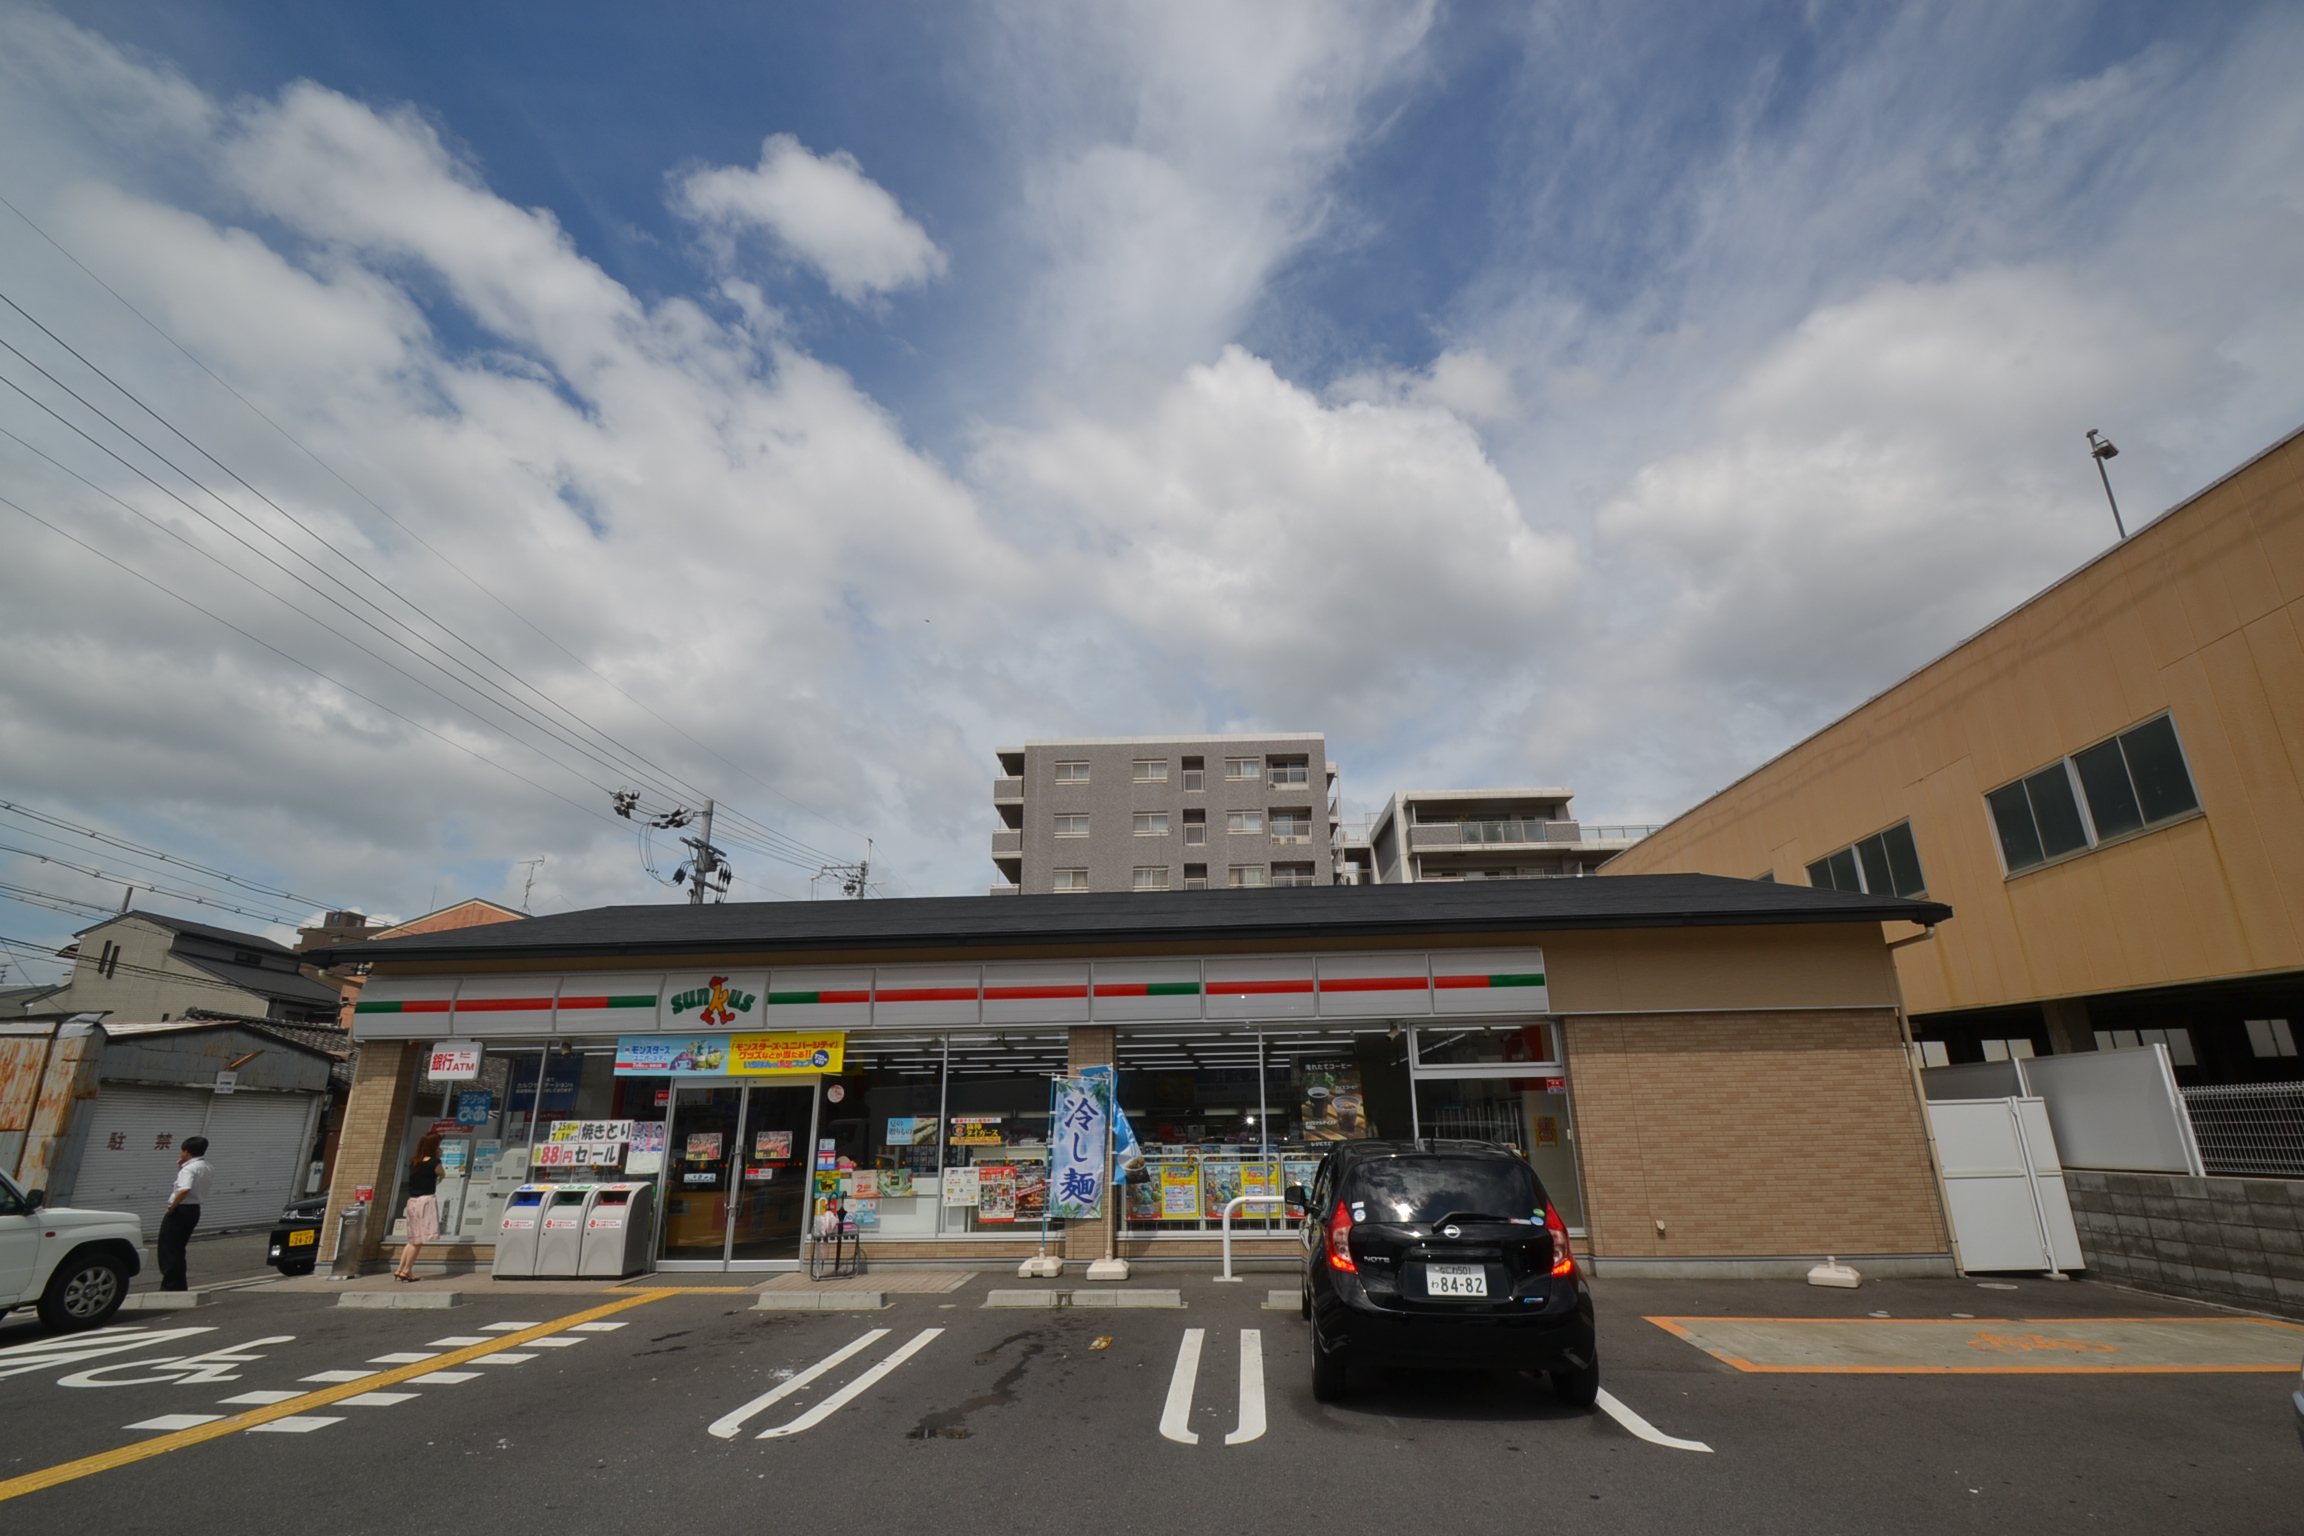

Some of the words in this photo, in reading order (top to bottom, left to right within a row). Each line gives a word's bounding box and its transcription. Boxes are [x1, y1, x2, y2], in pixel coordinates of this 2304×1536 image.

[431, 1053, 455, 1072] 銀行
[452, 1062, 475, 1072] ATM
[581, 1122, 632, 1141] 焼きとり
[1060, 1097, 1100, 1204] 冷し麺
[1363, 1255, 1391, 1264] NOTE
[1431, 1280, 1439, 1289] わ
[1440, 1276, 1484, 1294] 84-82
